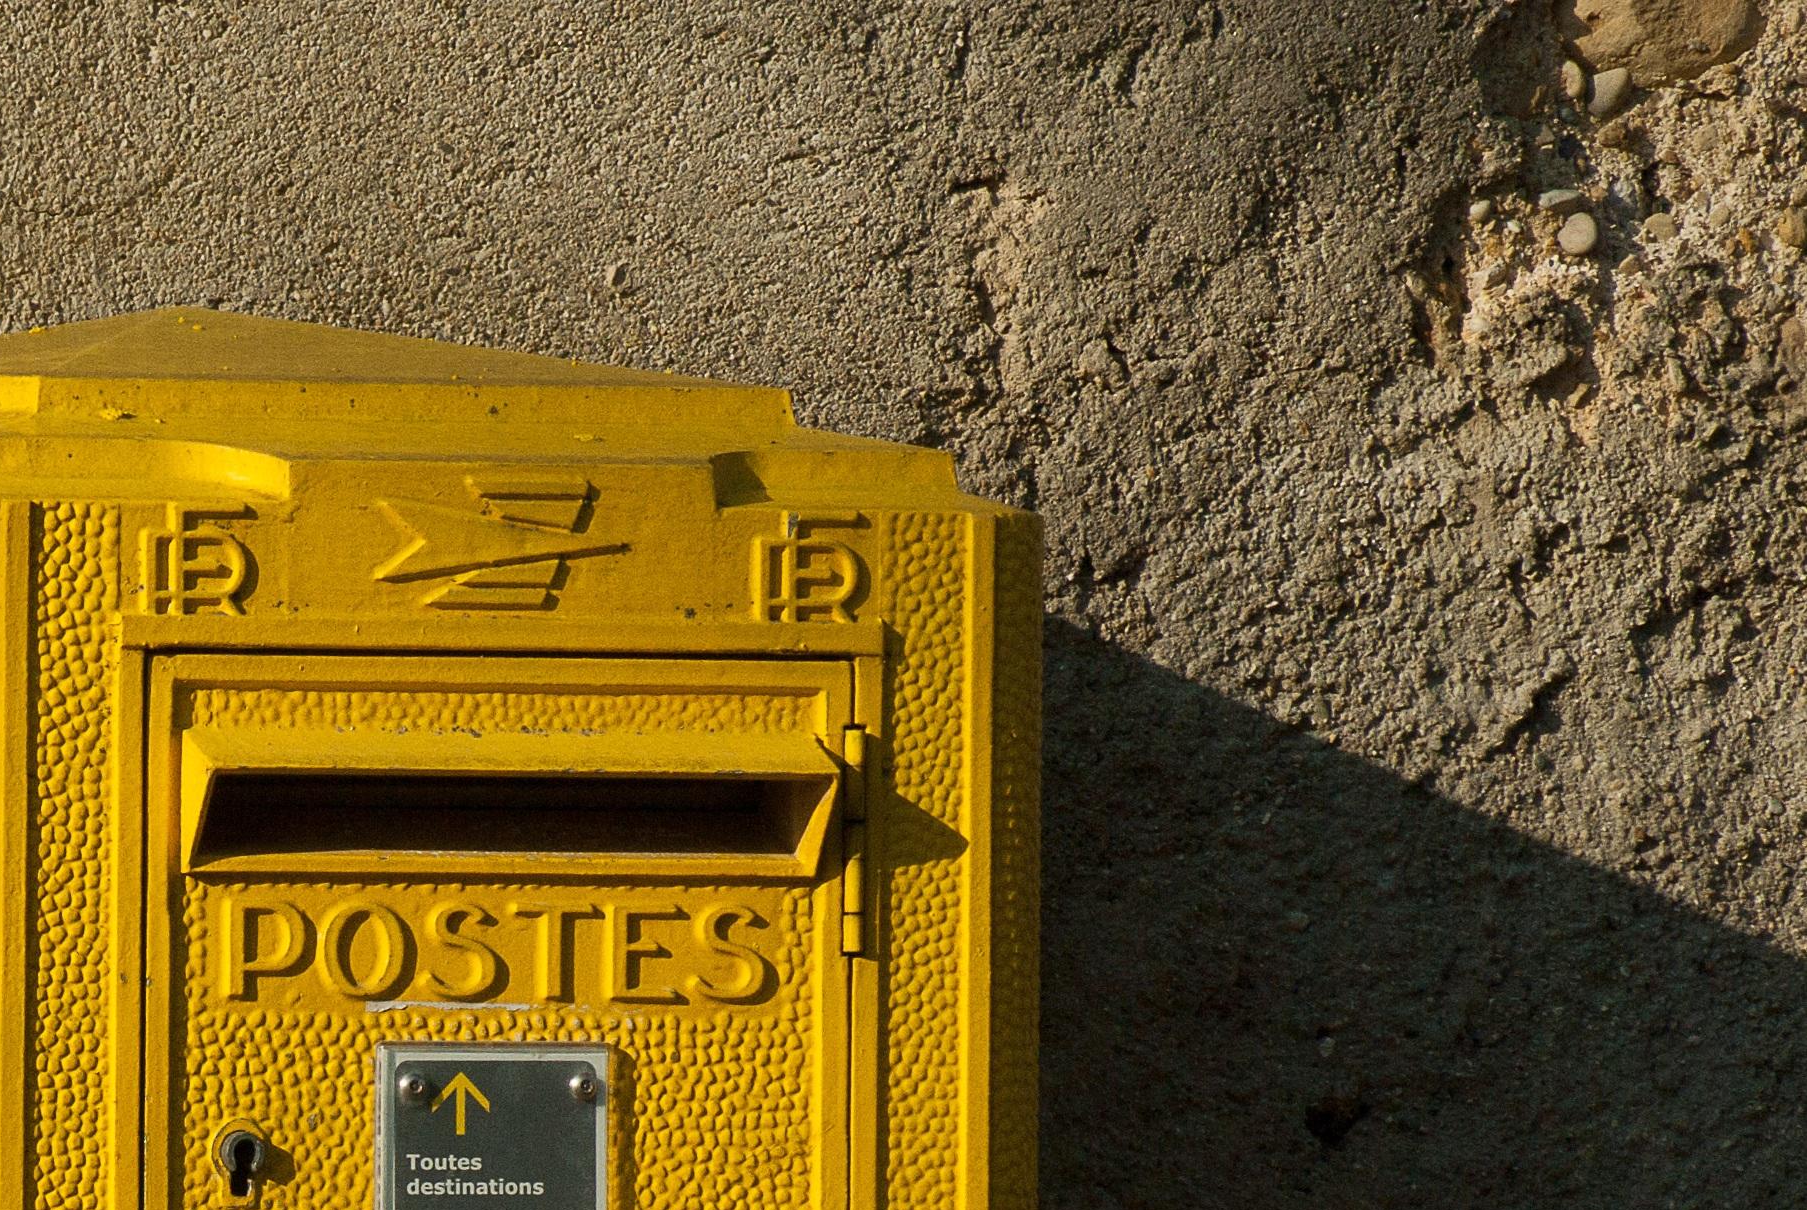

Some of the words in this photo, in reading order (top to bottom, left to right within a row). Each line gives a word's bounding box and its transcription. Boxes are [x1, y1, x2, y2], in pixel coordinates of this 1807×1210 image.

[217, 898, 780, 1005] POSTES
[406, 1154, 482, 1170] Toutes
[406, 1179, 544, 1195] destinations
